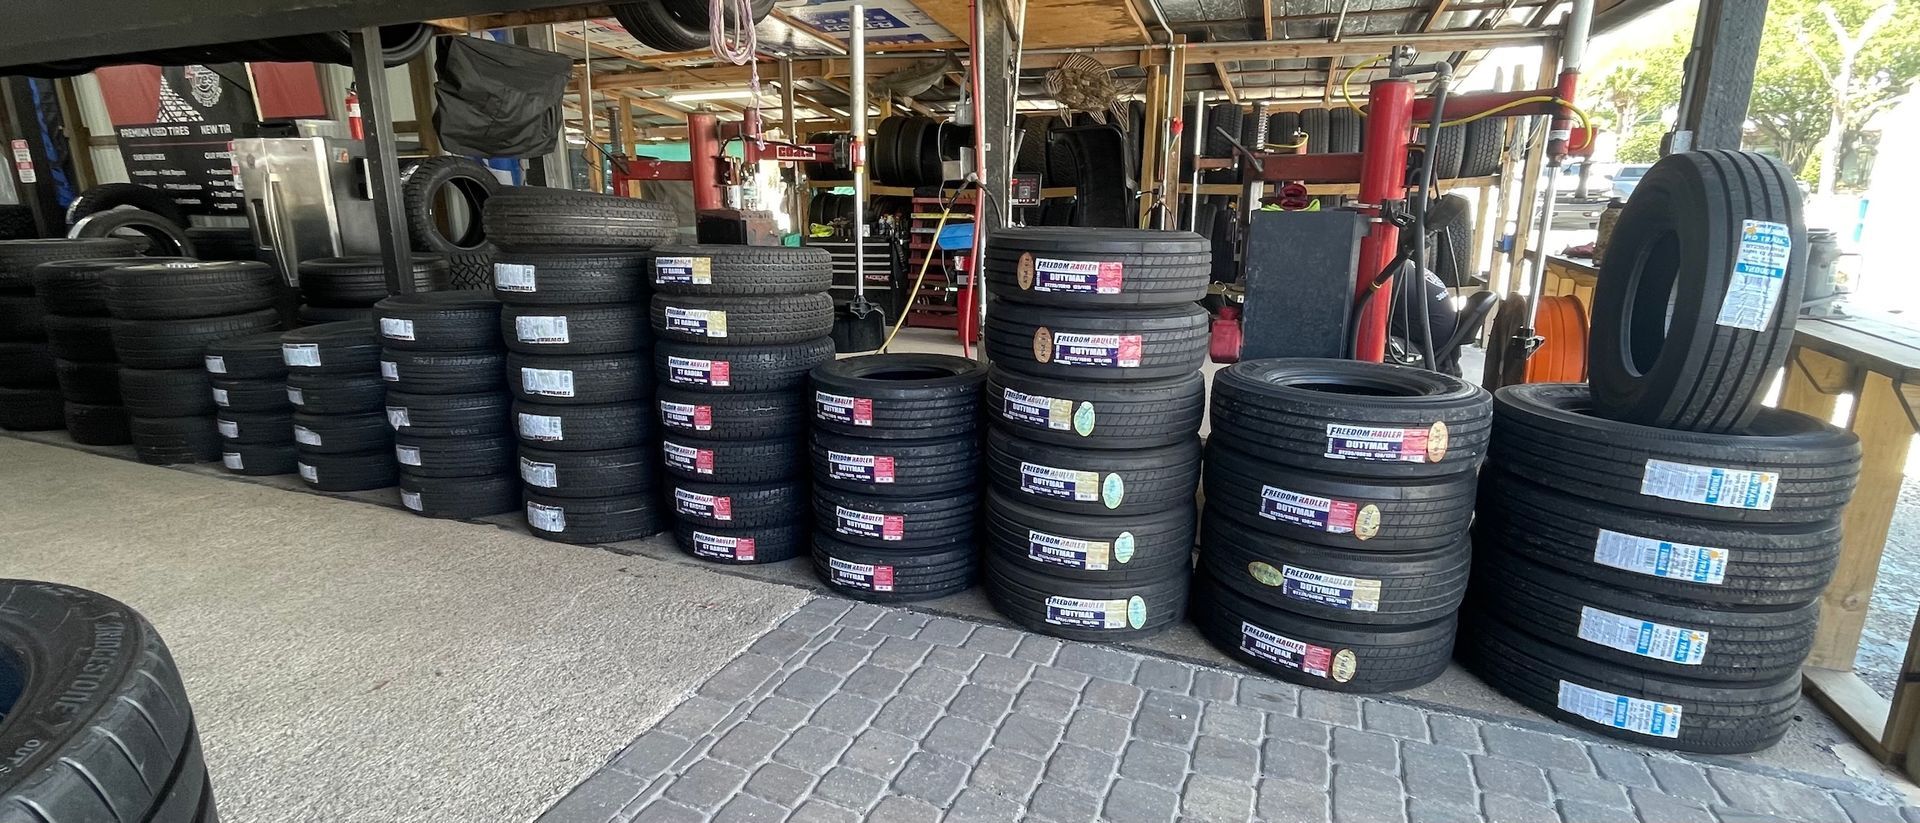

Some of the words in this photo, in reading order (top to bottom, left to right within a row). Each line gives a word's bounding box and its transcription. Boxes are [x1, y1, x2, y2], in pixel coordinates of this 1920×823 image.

[120, 127, 150, 138] PREMIUM
[150, 127, 167, 137] USED
[167, 126, 190, 136] TIRES
[200, 124, 218, 135] NEW
[1037, 260, 1070, 270] FREEDOM
[1069, 262, 1097, 271] HAULER
[1050, 273, 1086, 283] DUTYMAX
[1056, 335, 1091, 344] FREEDOM
[1090, 336, 1117, 345] HAULER
[1070, 346, 1107, 356] DUTYMAX
[1330, 426, 1370, 437] FREEDOM
[1370, 430, 1402, 439] HAULER
[1346, 440, 1389, 451] DUTYMAX
[1022, 465, 1050, 476] FREEDOM
[1050, 468, 1075, 480] HAULER
[1033, 477, 1065, 489] DUTYMAX
[1263, 488, 1298, 502] FREEDOM
[1298, 496, 1329, 508] HAULER
[1276, 502, 1316, 519] DUTYMAX
[1031, 533, 1060, 545] FREEDOM
[1060, 538, 1086, 550] HAULER
[1042, 546, 1075, 559] DUTYMAX
[1284, 567, 1322, 581] FREEDOM
[1322, 576, 1354, 587] HAULER
[1300, 581, 1341, 597] DUTYMAX
[1047, 597, 1079, 608] FREEDOM
[1079, 601, 1105, 609] HAULER
[1060, 609, 1095, 619] DUTYMAX
[1244, 624, 1276, 642] FREEDOM
[1275, 637, 1304, 652] HAULER
[1255, 640, 1292, 660] DUTYMAX
